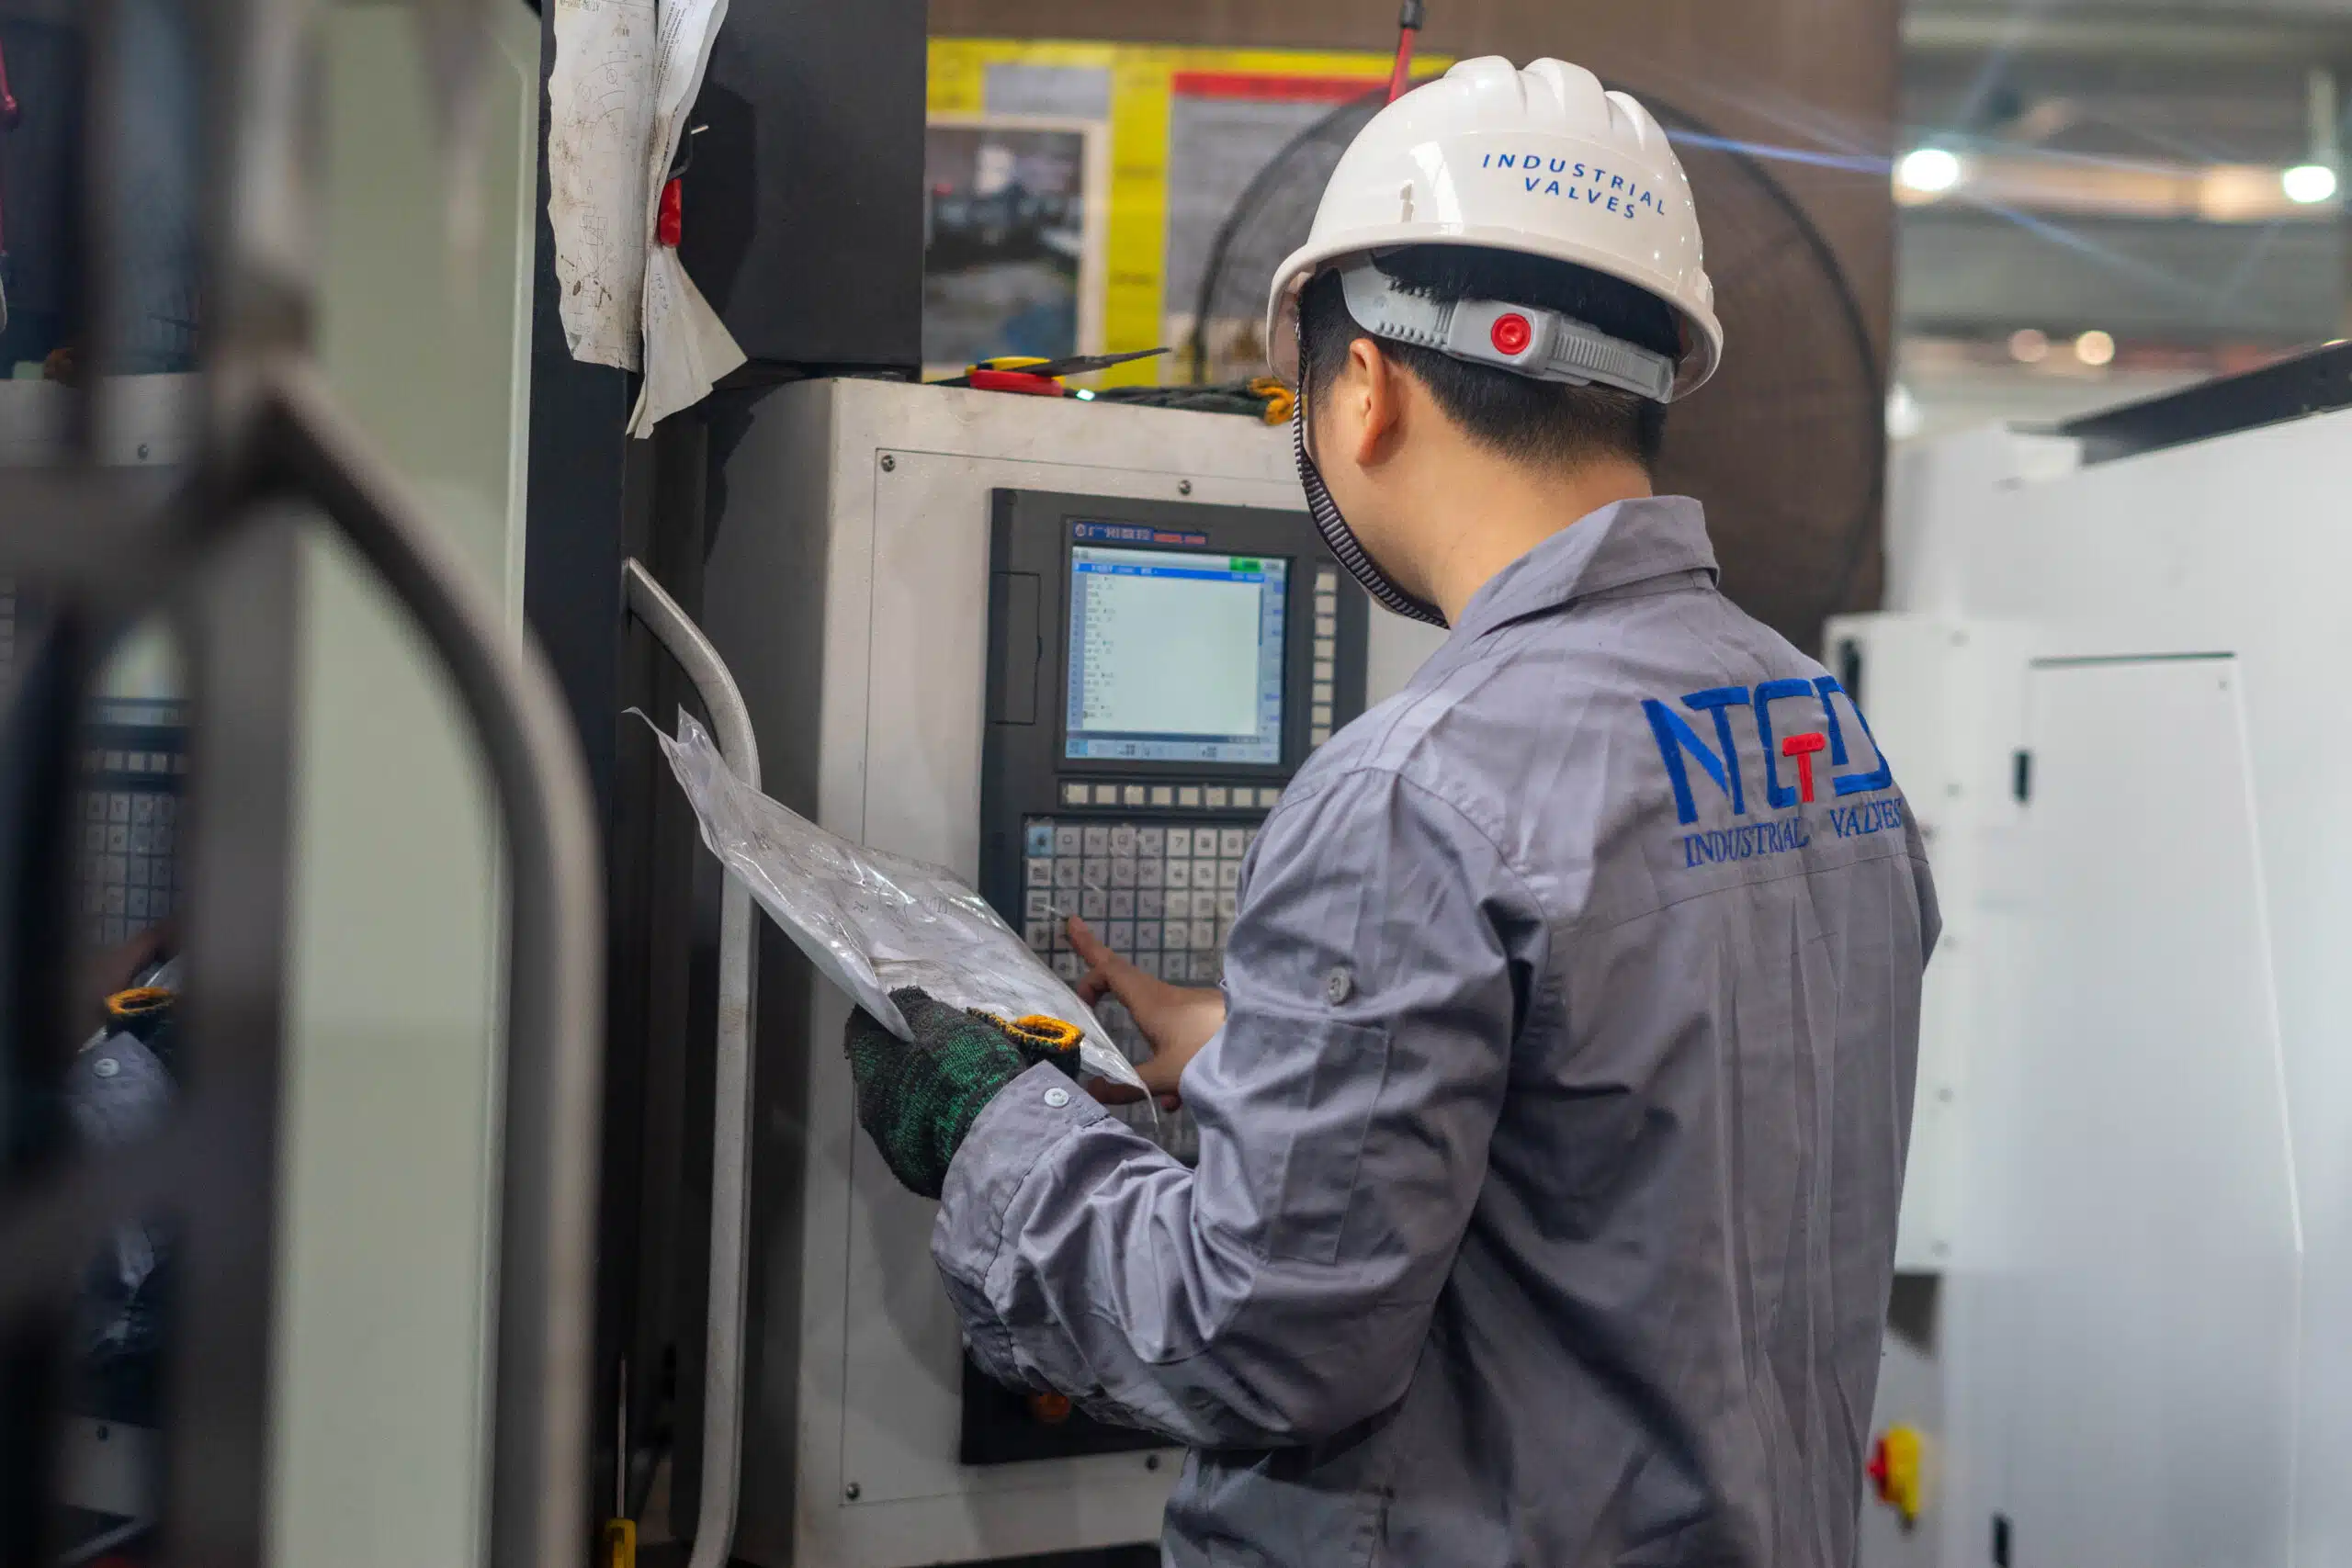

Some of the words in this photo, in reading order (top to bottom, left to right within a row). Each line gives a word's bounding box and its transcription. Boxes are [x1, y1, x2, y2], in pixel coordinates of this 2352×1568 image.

[1482, 153, 1665, 216] INDUSTRIAL
[1524, 176, 1635, 220] VALVES
[1683, 818, 1810, 868] INDUSTRIAL
